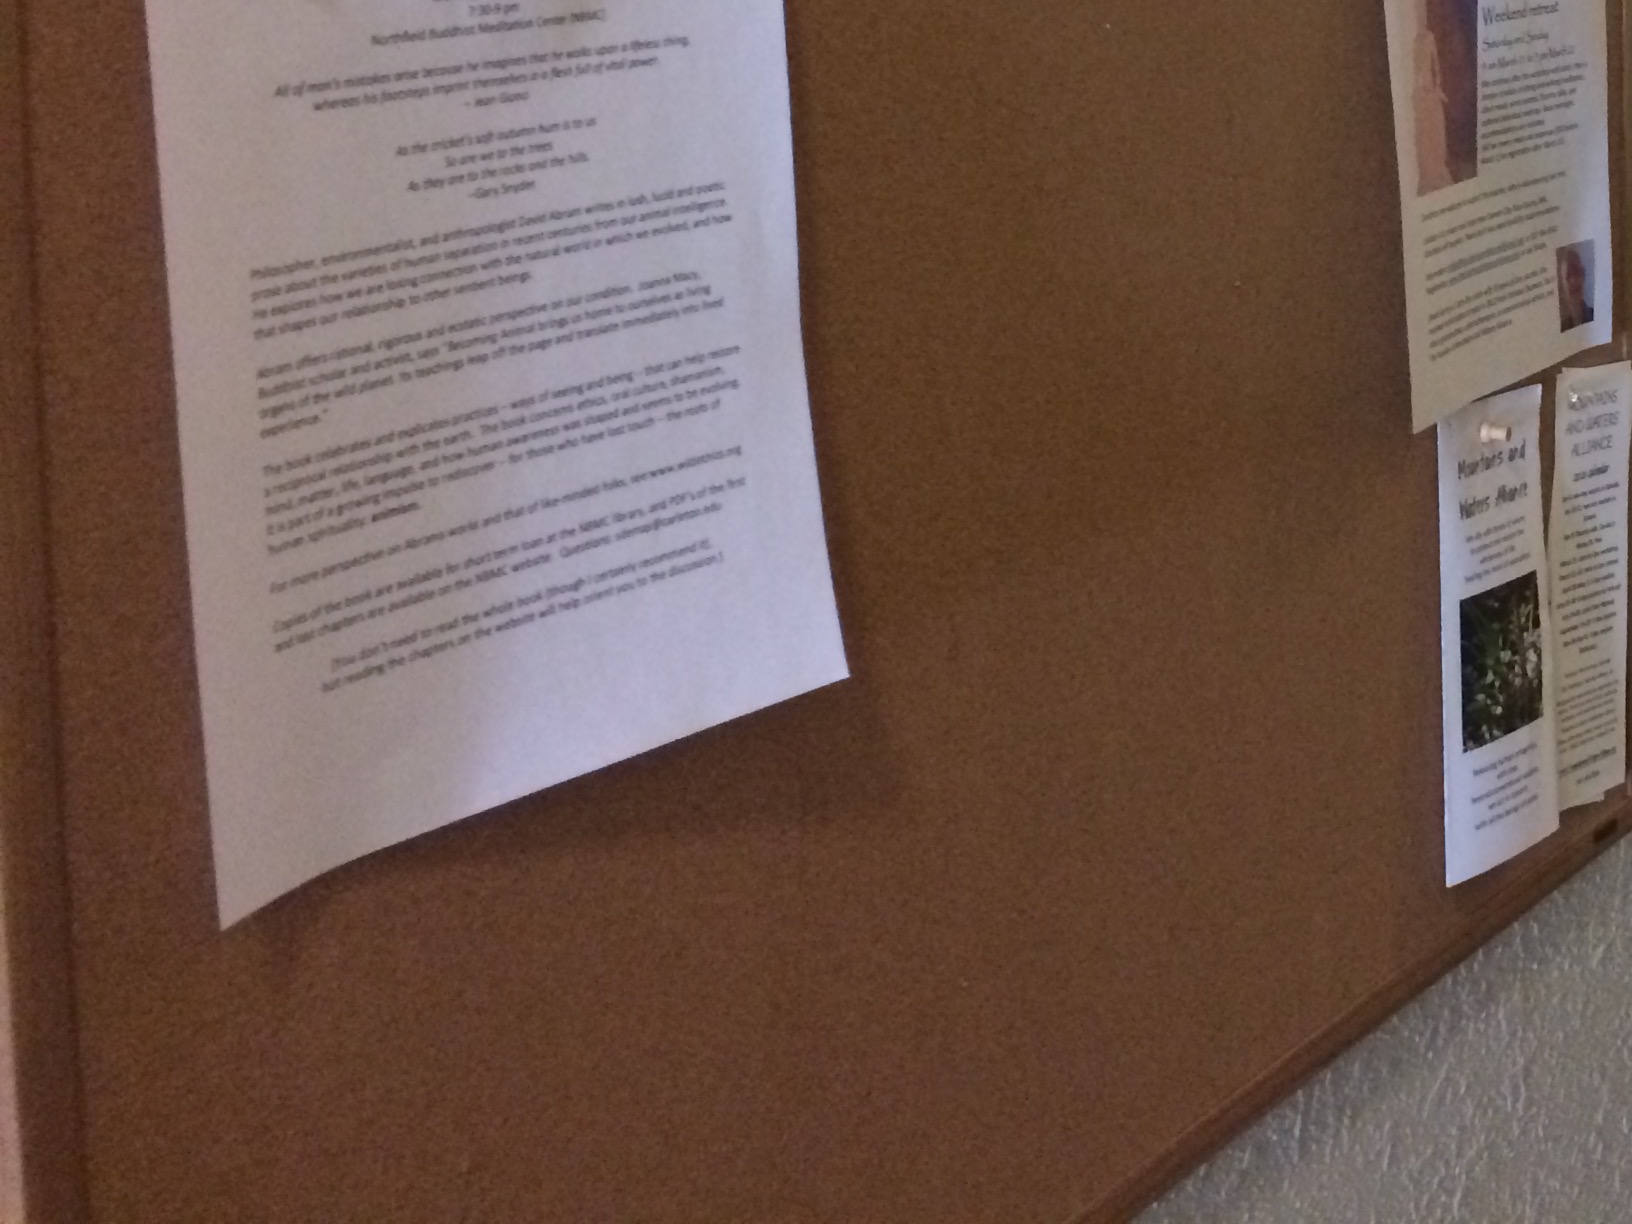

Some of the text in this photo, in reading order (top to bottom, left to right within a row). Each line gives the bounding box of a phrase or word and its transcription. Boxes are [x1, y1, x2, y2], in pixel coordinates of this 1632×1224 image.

[1482, 1, 1559, 25] Weekend retreat
[370, 30, 427, 46] Northfield
[427, 26, 476, 40] Buddhist
[477, 20, 534, 33] Meditation
[536, 15, 568, 28] Center
[518, 213, 548, 227] David
[548, 207, 583, 221] Abram
[1508, 438, 1526, 463] and
[1571, 434, 1612, 456] ALLIANCE
